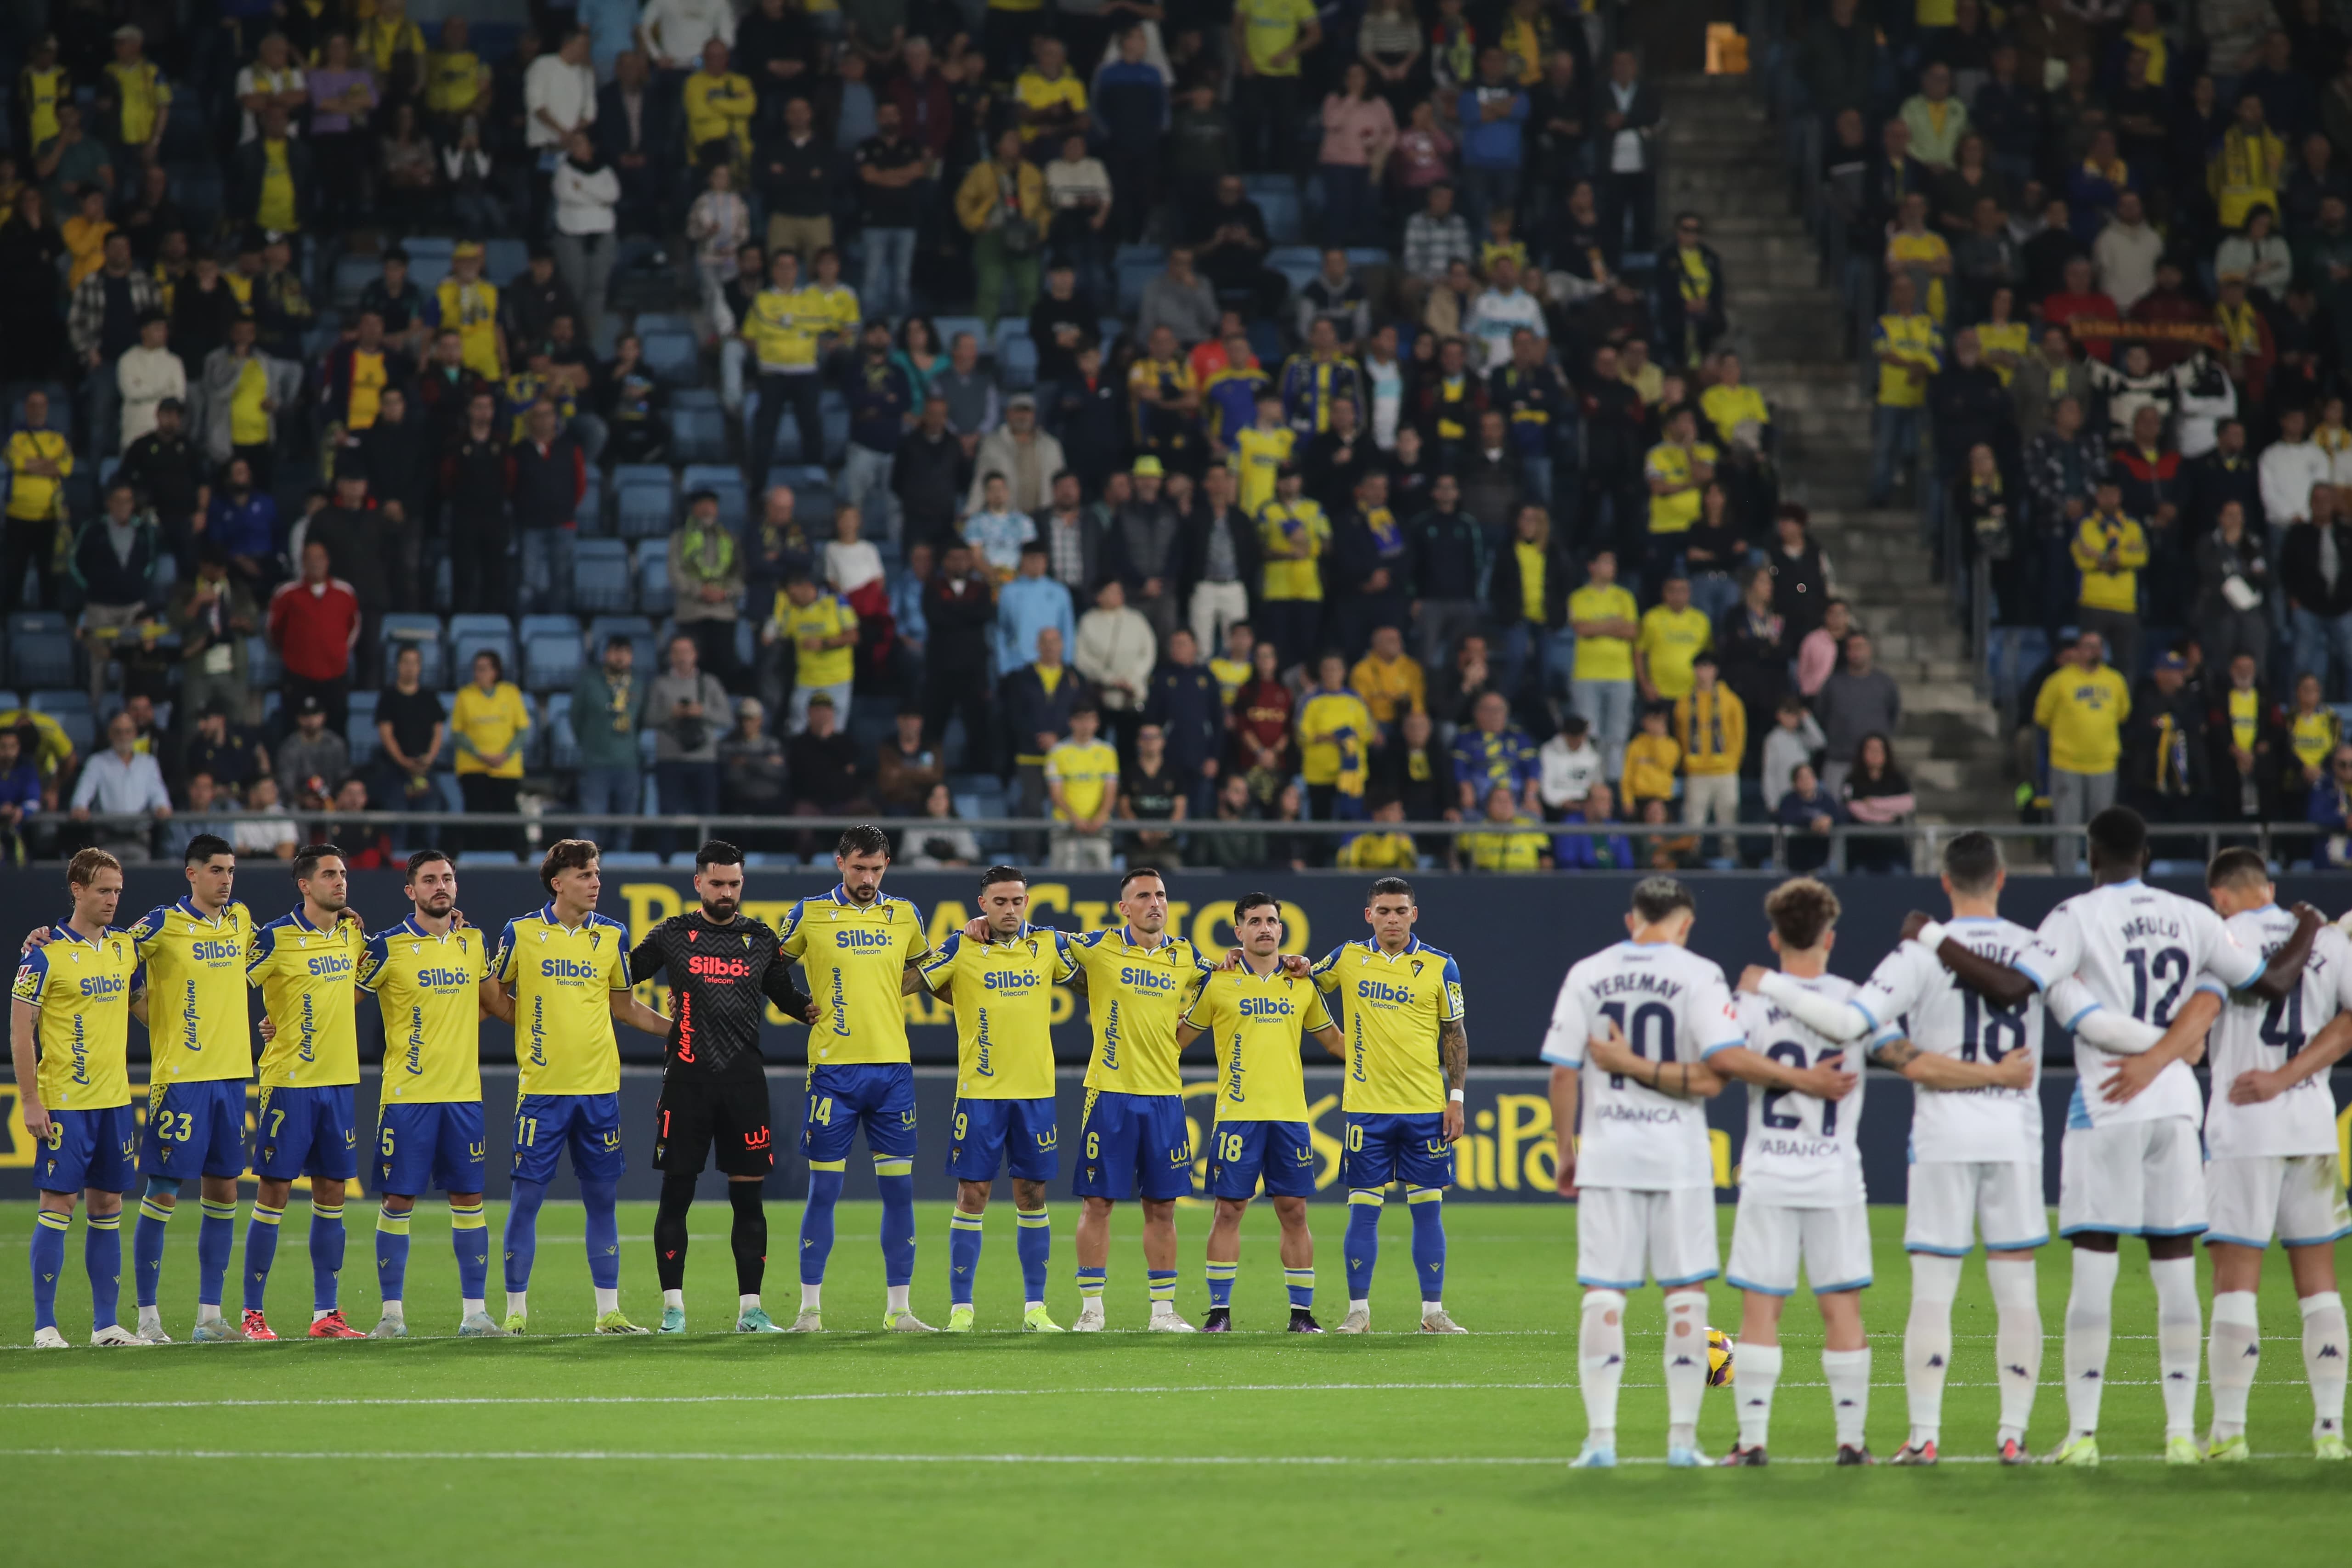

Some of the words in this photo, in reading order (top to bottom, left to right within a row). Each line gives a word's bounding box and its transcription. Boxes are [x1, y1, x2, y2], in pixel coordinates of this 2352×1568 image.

[2121, 917, 2180, 943] MFULU
[323, 974, 347, 983] Telecom
[556, 979, 584, 987] Telecom
[703, 976, 734, 985] Telecom
[1134, 987, 1163, 998] Telecom
[1589, 973, 1683, 1000] YEREMAY
[2123, 947, 2189, 1029] 12
[95, 995, 118, 1003] Telecom
[1369, 1000, 1399, 1010] Telecom
[1951, 974, 2029, 1063] 18
[2260, 972, 2306, 1061] 4
[1598, 1001, 1676, 1090] 10
[1762, 1040, 1845, 1137] 21
[270, 1109, 285, 1138] 7
[663, 1109, 670, 1138] 1
[808, 1095, 832, 1126] 14
[1597, 1104, 1680, 1124] ABANCA
[158, 1110, 192, 1141] 23
[517, 1116, 537, 1147] 11
[954, 1113, 967, 1140] 9
[1346, 1122, 1363, 1152] 10
[382, 1127, 394, 1156] 5
[1086, 1132, 1099, 1159] 6
[1218, 1132, 1243, 1162] 18
[1762, 1139, 1840, 1157] ABANCA
